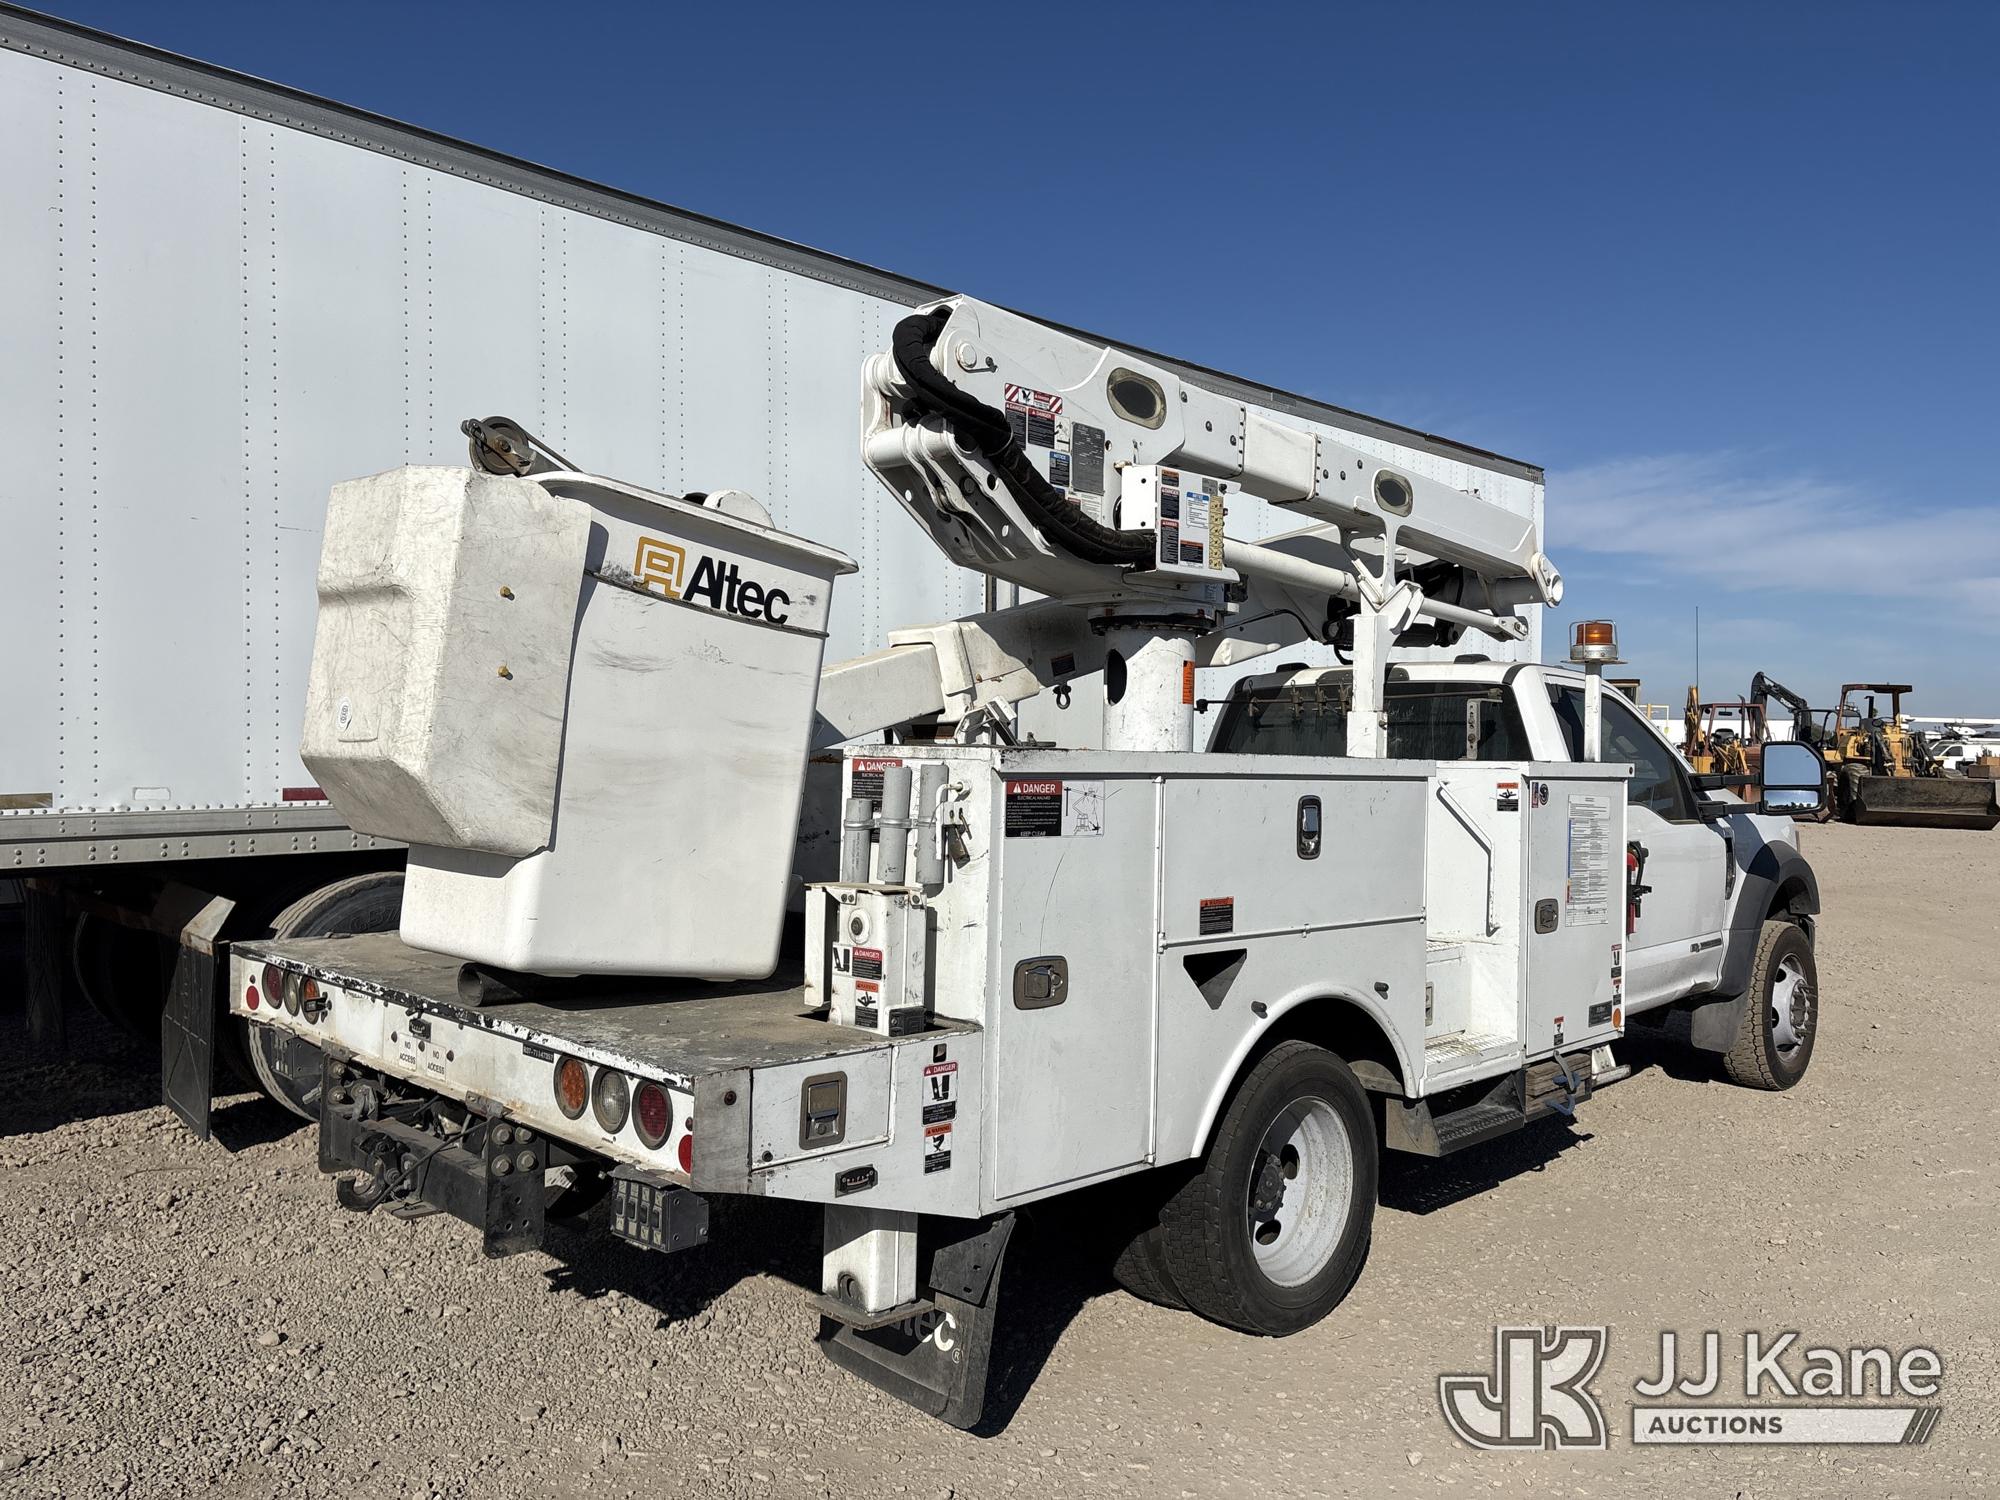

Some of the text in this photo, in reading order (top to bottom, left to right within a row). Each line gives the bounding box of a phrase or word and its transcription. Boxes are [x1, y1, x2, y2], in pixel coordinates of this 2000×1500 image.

[683, 555, 790, 625] Altec
[1023, 783, 1056, 794] DANGER
[859, 950, 880, 960] DANGER
[404, 1040, 411, 1050] NO
[399, 1053, 416, 1065] ACCESS
[432, 1050, 440, 1060] NO
[427, 1062, 445, 1075] ACCESS
[933, 1063, 956, 1074] DANGER
